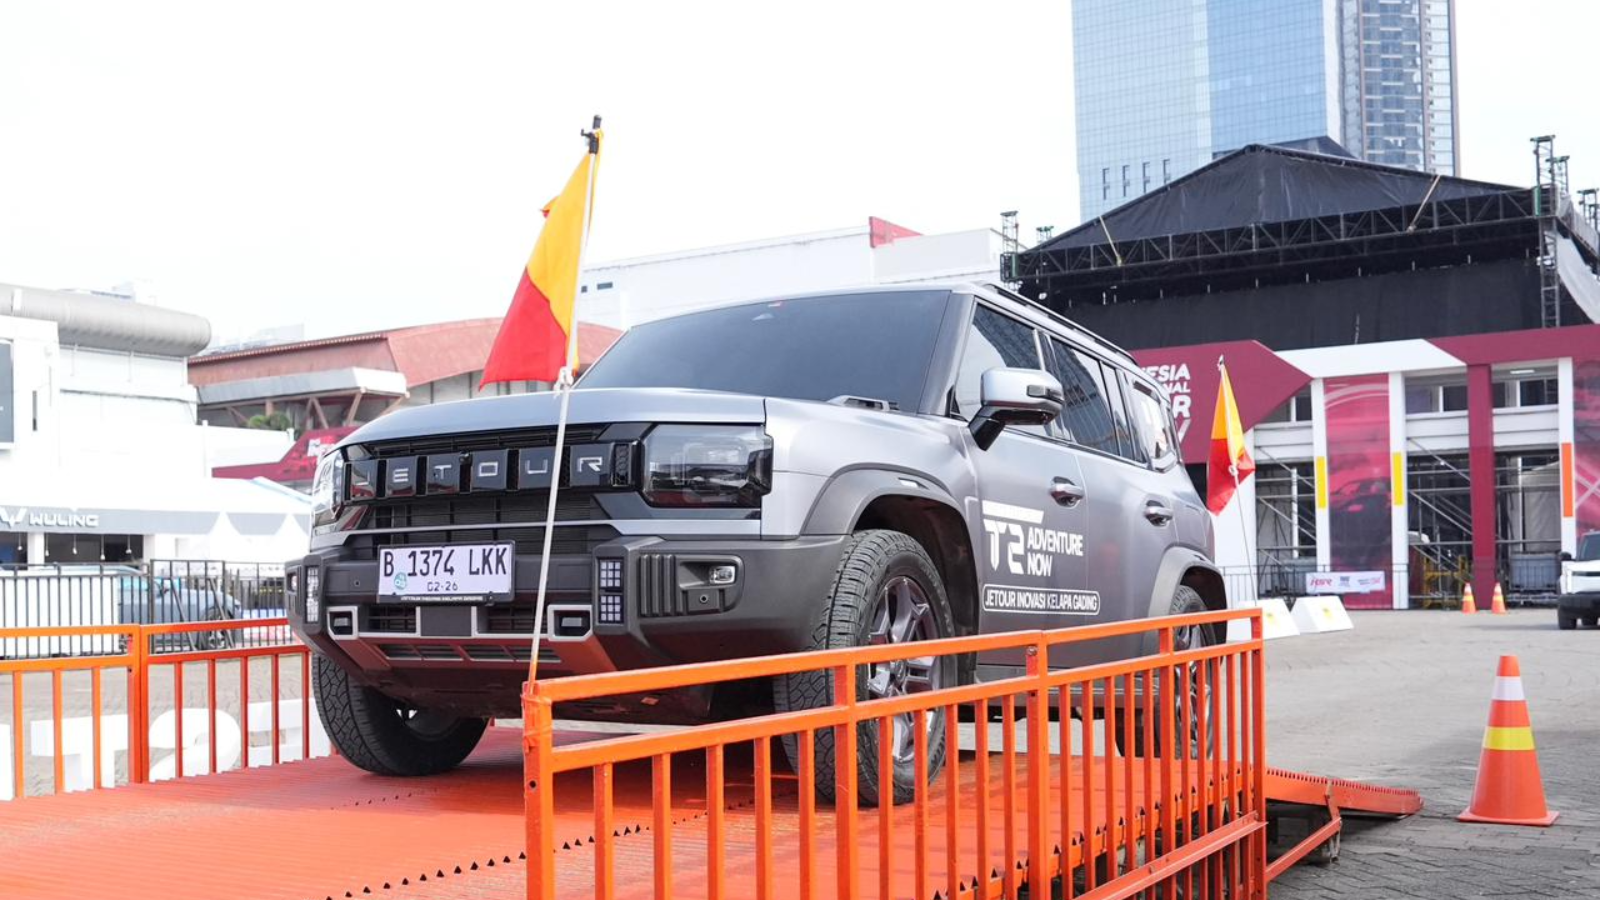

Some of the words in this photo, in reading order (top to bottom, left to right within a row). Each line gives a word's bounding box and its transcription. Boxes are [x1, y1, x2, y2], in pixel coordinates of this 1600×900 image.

[29, 512, 100, 527] WULING
[1027, 526, 1084, 557] ADVENTURE
[383, 551, 395, 577] B
[407, 549, 455, 577] 1374
[469, 547, 508, 575] LKK
[1027, 553, 1053, 577] NOW
[985, 589, 1016, 608] JETOUR
[1017, 591, 1046, 609] INOVASI
[1047, 593, 1072, 610] KELAPA
[1073, 594, 1097, 611] GADING
